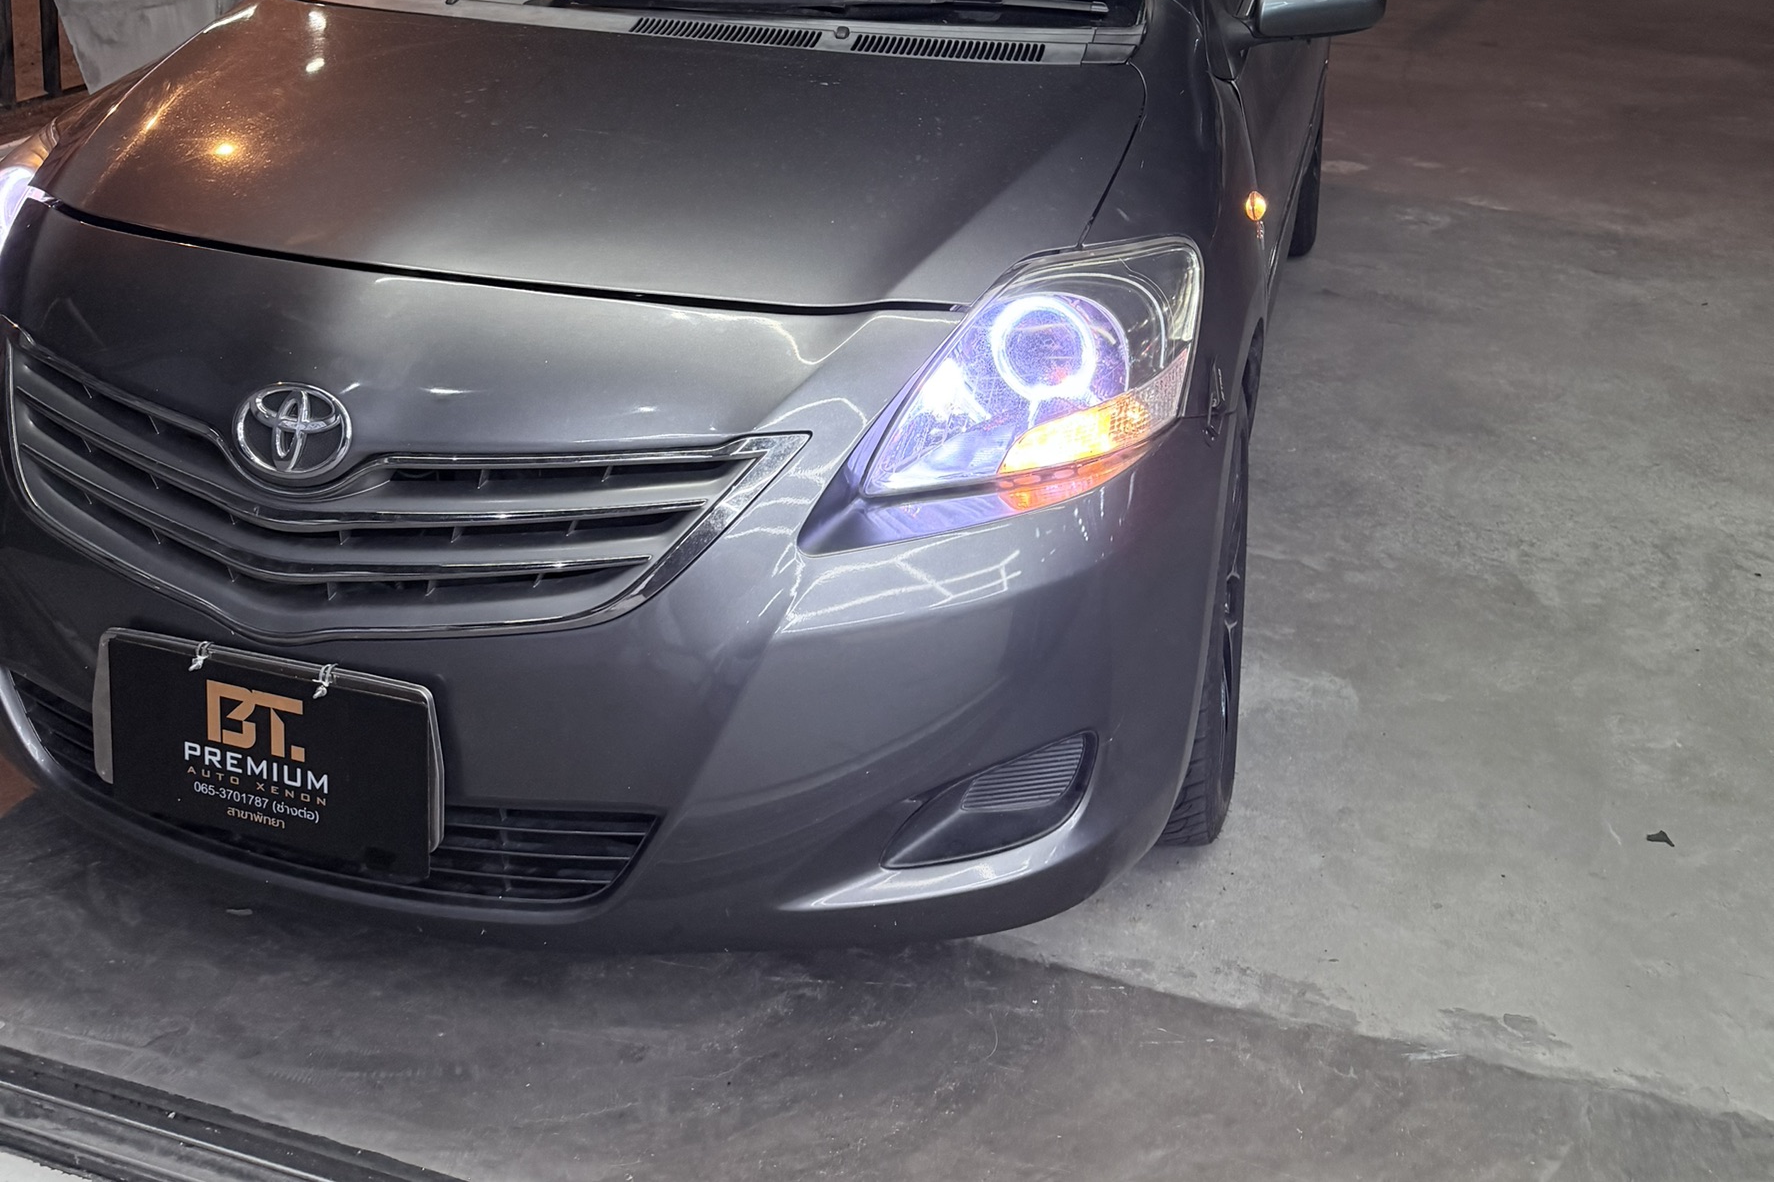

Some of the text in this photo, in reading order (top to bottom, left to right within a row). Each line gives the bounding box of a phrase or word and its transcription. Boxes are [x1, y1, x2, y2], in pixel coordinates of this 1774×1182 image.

[184, 741, 328, 793] PREMIUM
[187, 766, 326, 806] AUTO XENON
[194, 781, 319, 823] 065-3701787 (ช่างต่อ)
[227, 806, 285, 829] สาขาพัทยา
